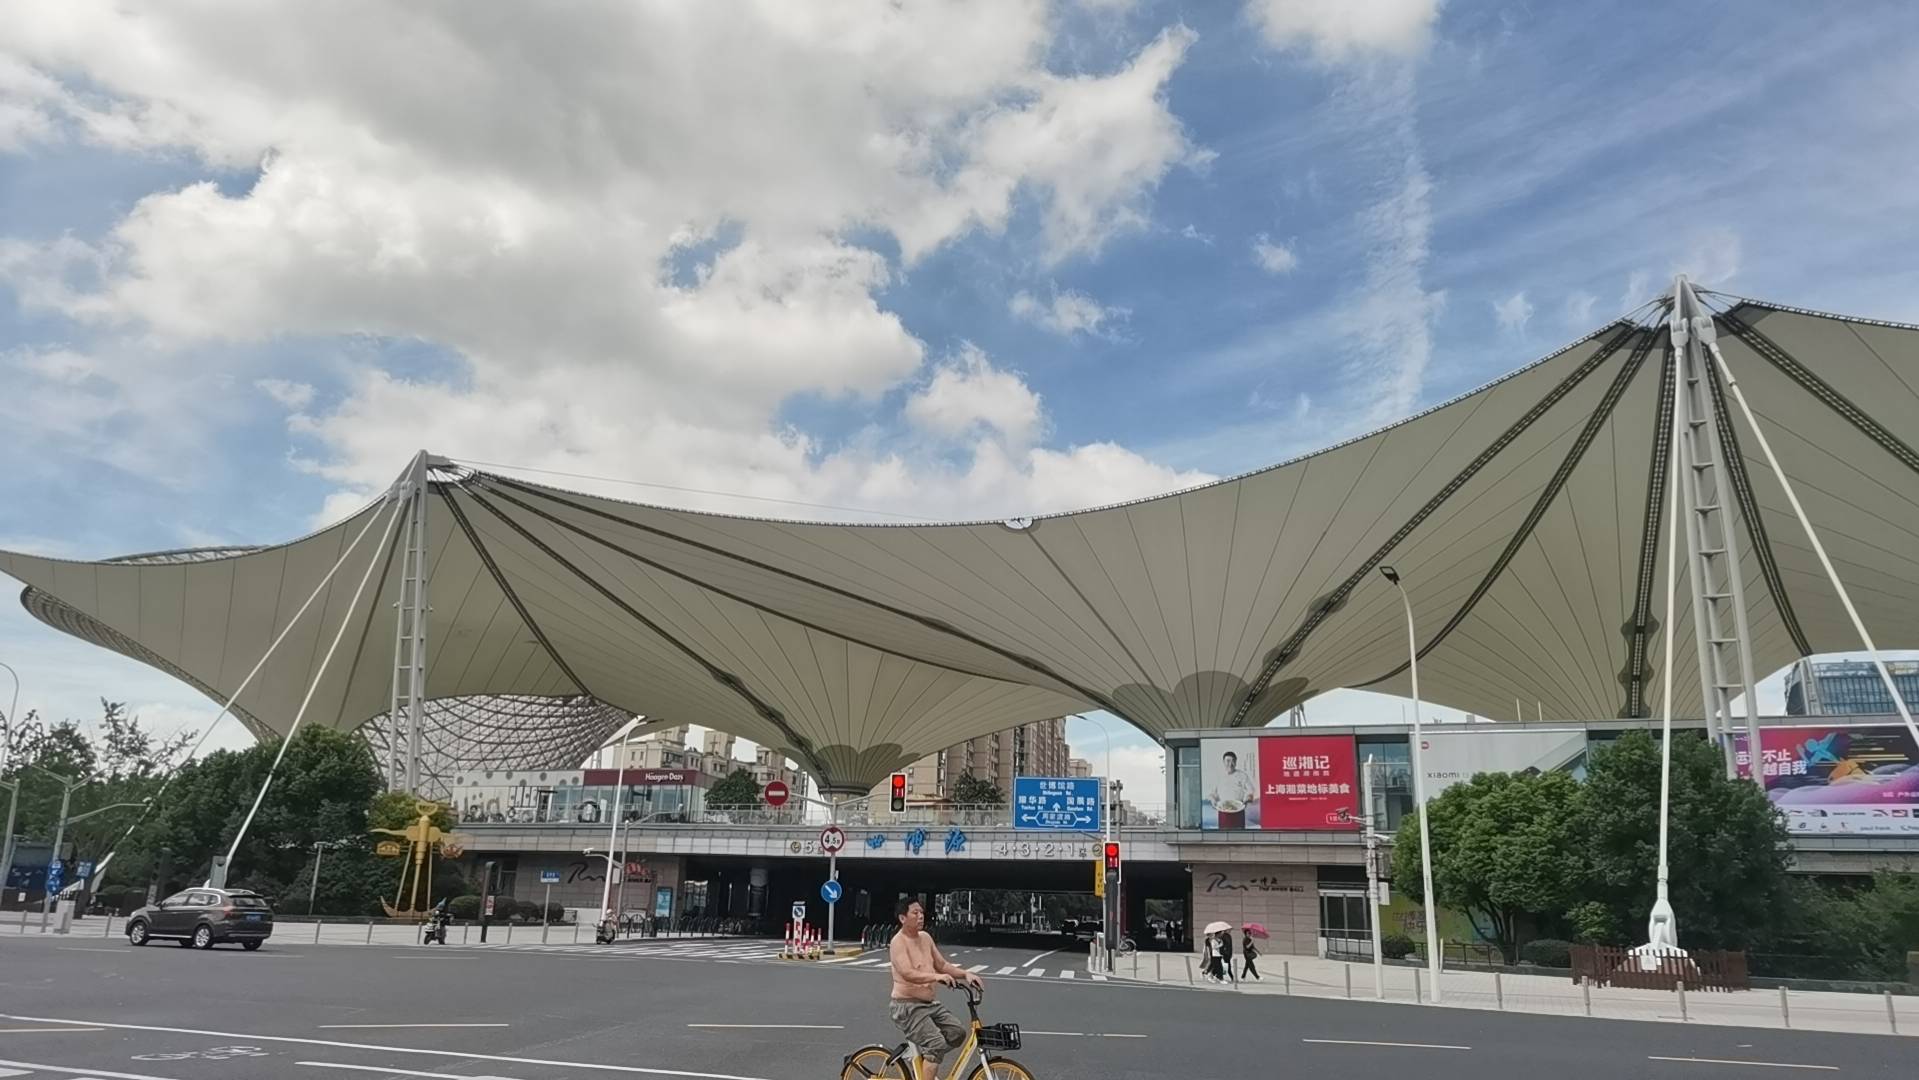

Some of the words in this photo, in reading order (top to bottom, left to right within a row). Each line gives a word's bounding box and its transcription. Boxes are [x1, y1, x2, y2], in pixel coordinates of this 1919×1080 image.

[1282, 755, 1330, 770] 巡湘记
[1736, 748, 1793, 765] 运不止
[1748, 760, 1808, 776] 越自我
[1265, 783, 1350, 795] 上海湘菜地标美食
